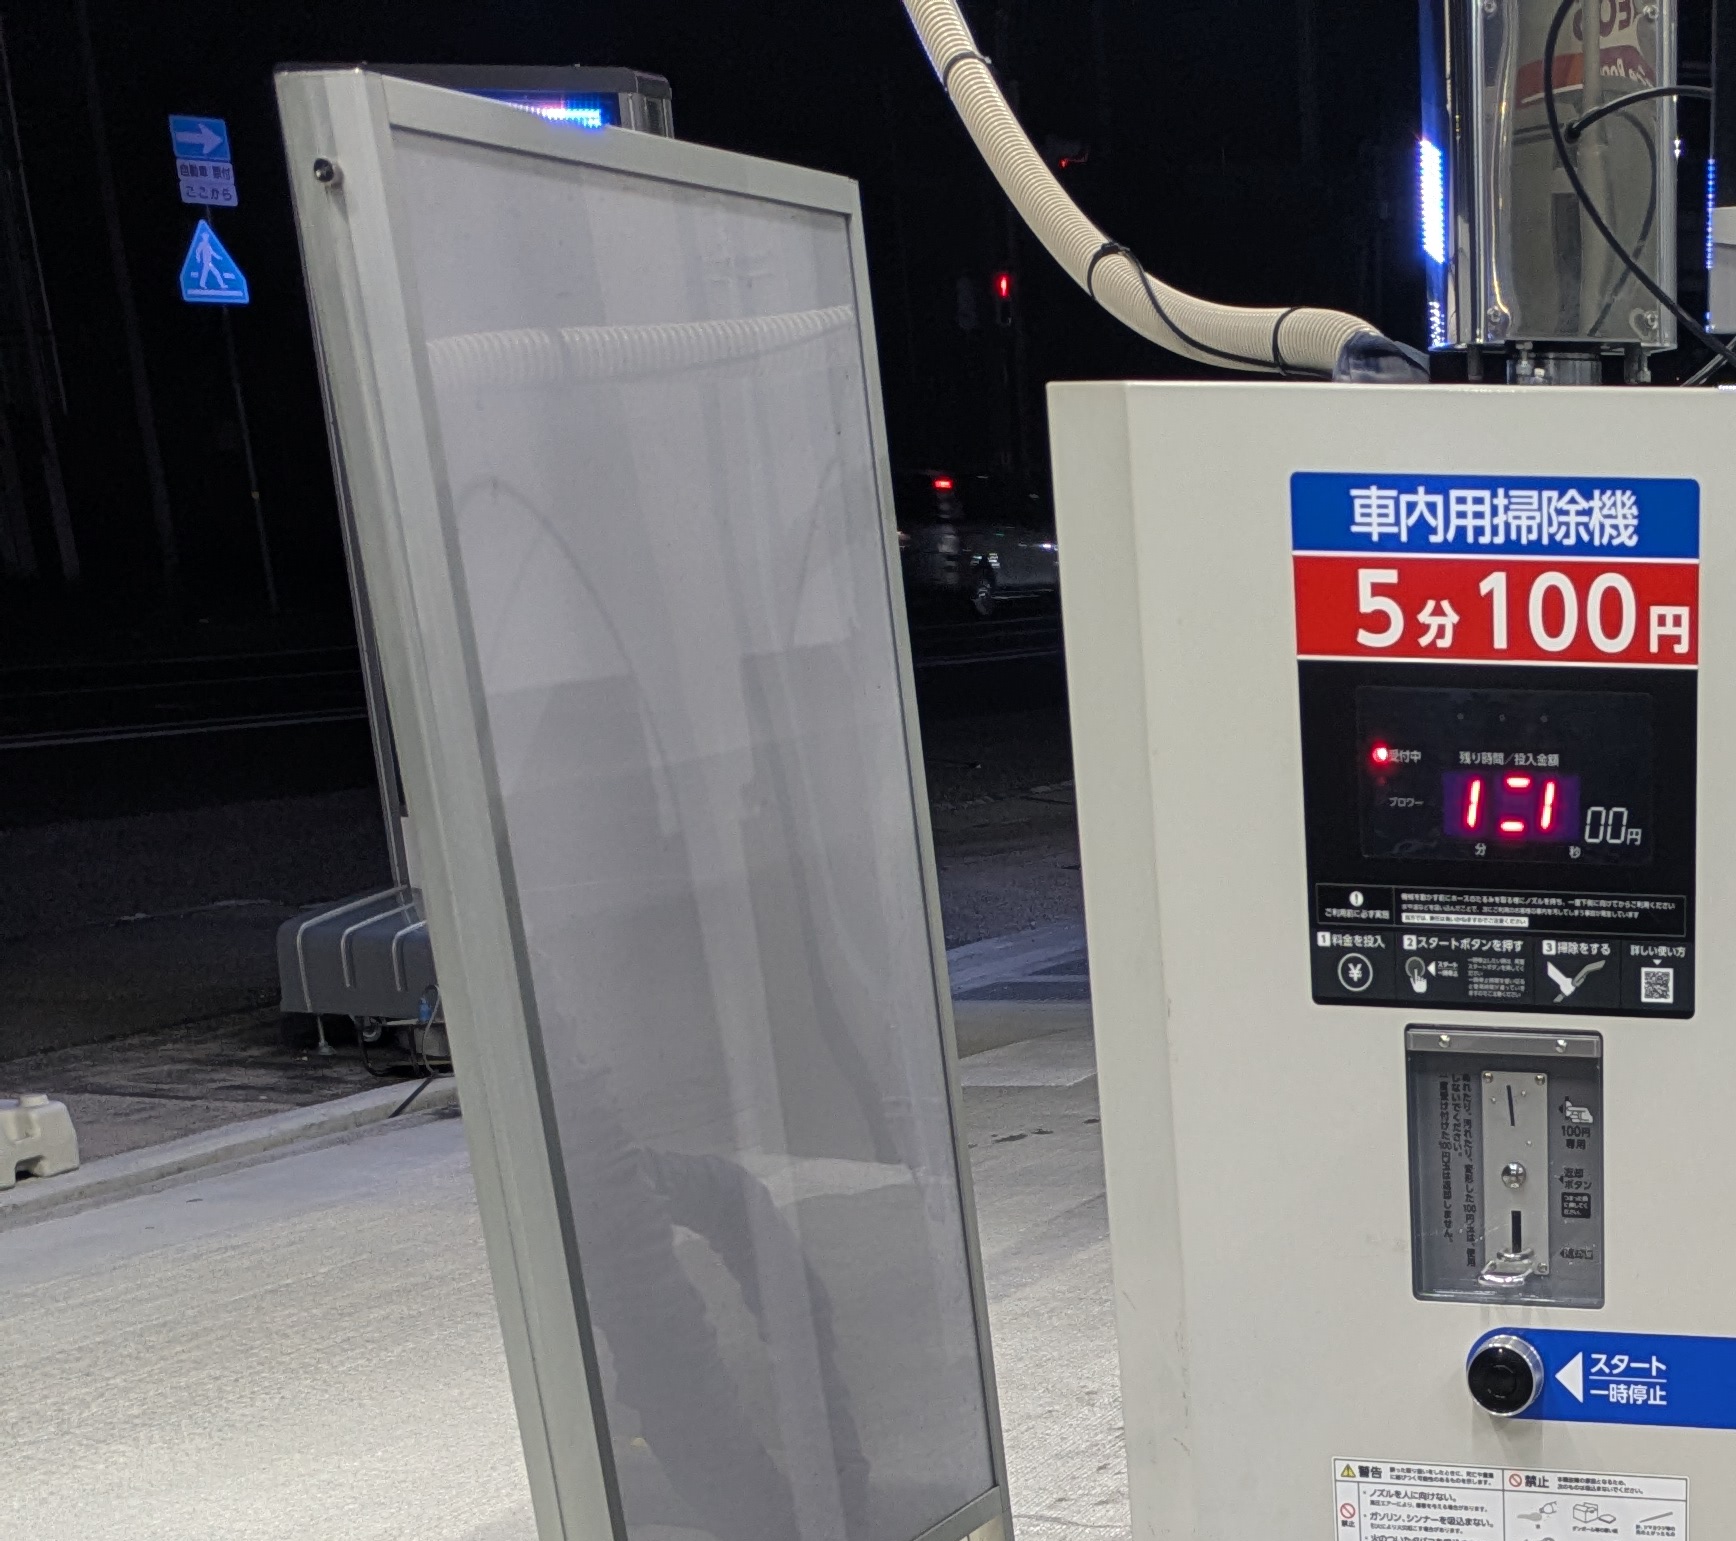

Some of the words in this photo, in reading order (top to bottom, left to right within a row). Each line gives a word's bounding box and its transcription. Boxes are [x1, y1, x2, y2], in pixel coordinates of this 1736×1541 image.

[186, 186, 232, 200] ここから
[1349, 486, 1639, 547] 車内用掃除機
[1475, 843, 1487, 856] 分
[1569, 845, 1582, 859] 秒
[1332, 934, 1386, 949] 料金を投入
[1417, 936, 1524, 952] スタートボタンを押す
[1557, 941, 1612, 956] 掃除をする
[1630, 944, 1686, 958] 詳しい使い方
[1561, 1125, 1591, 1138] 100円
[1566, 1139, 1586, 1150] 専用
[1564, 1179, 1592, 1191] ボタン
[1590, 1353, 1667, 1377] スタート
[1589, 1383, 1668, 1406] 一時停止
[1358, 1465, 1383, 1479] 警告
[1525, 1474, 1550, 1489] 禁止
